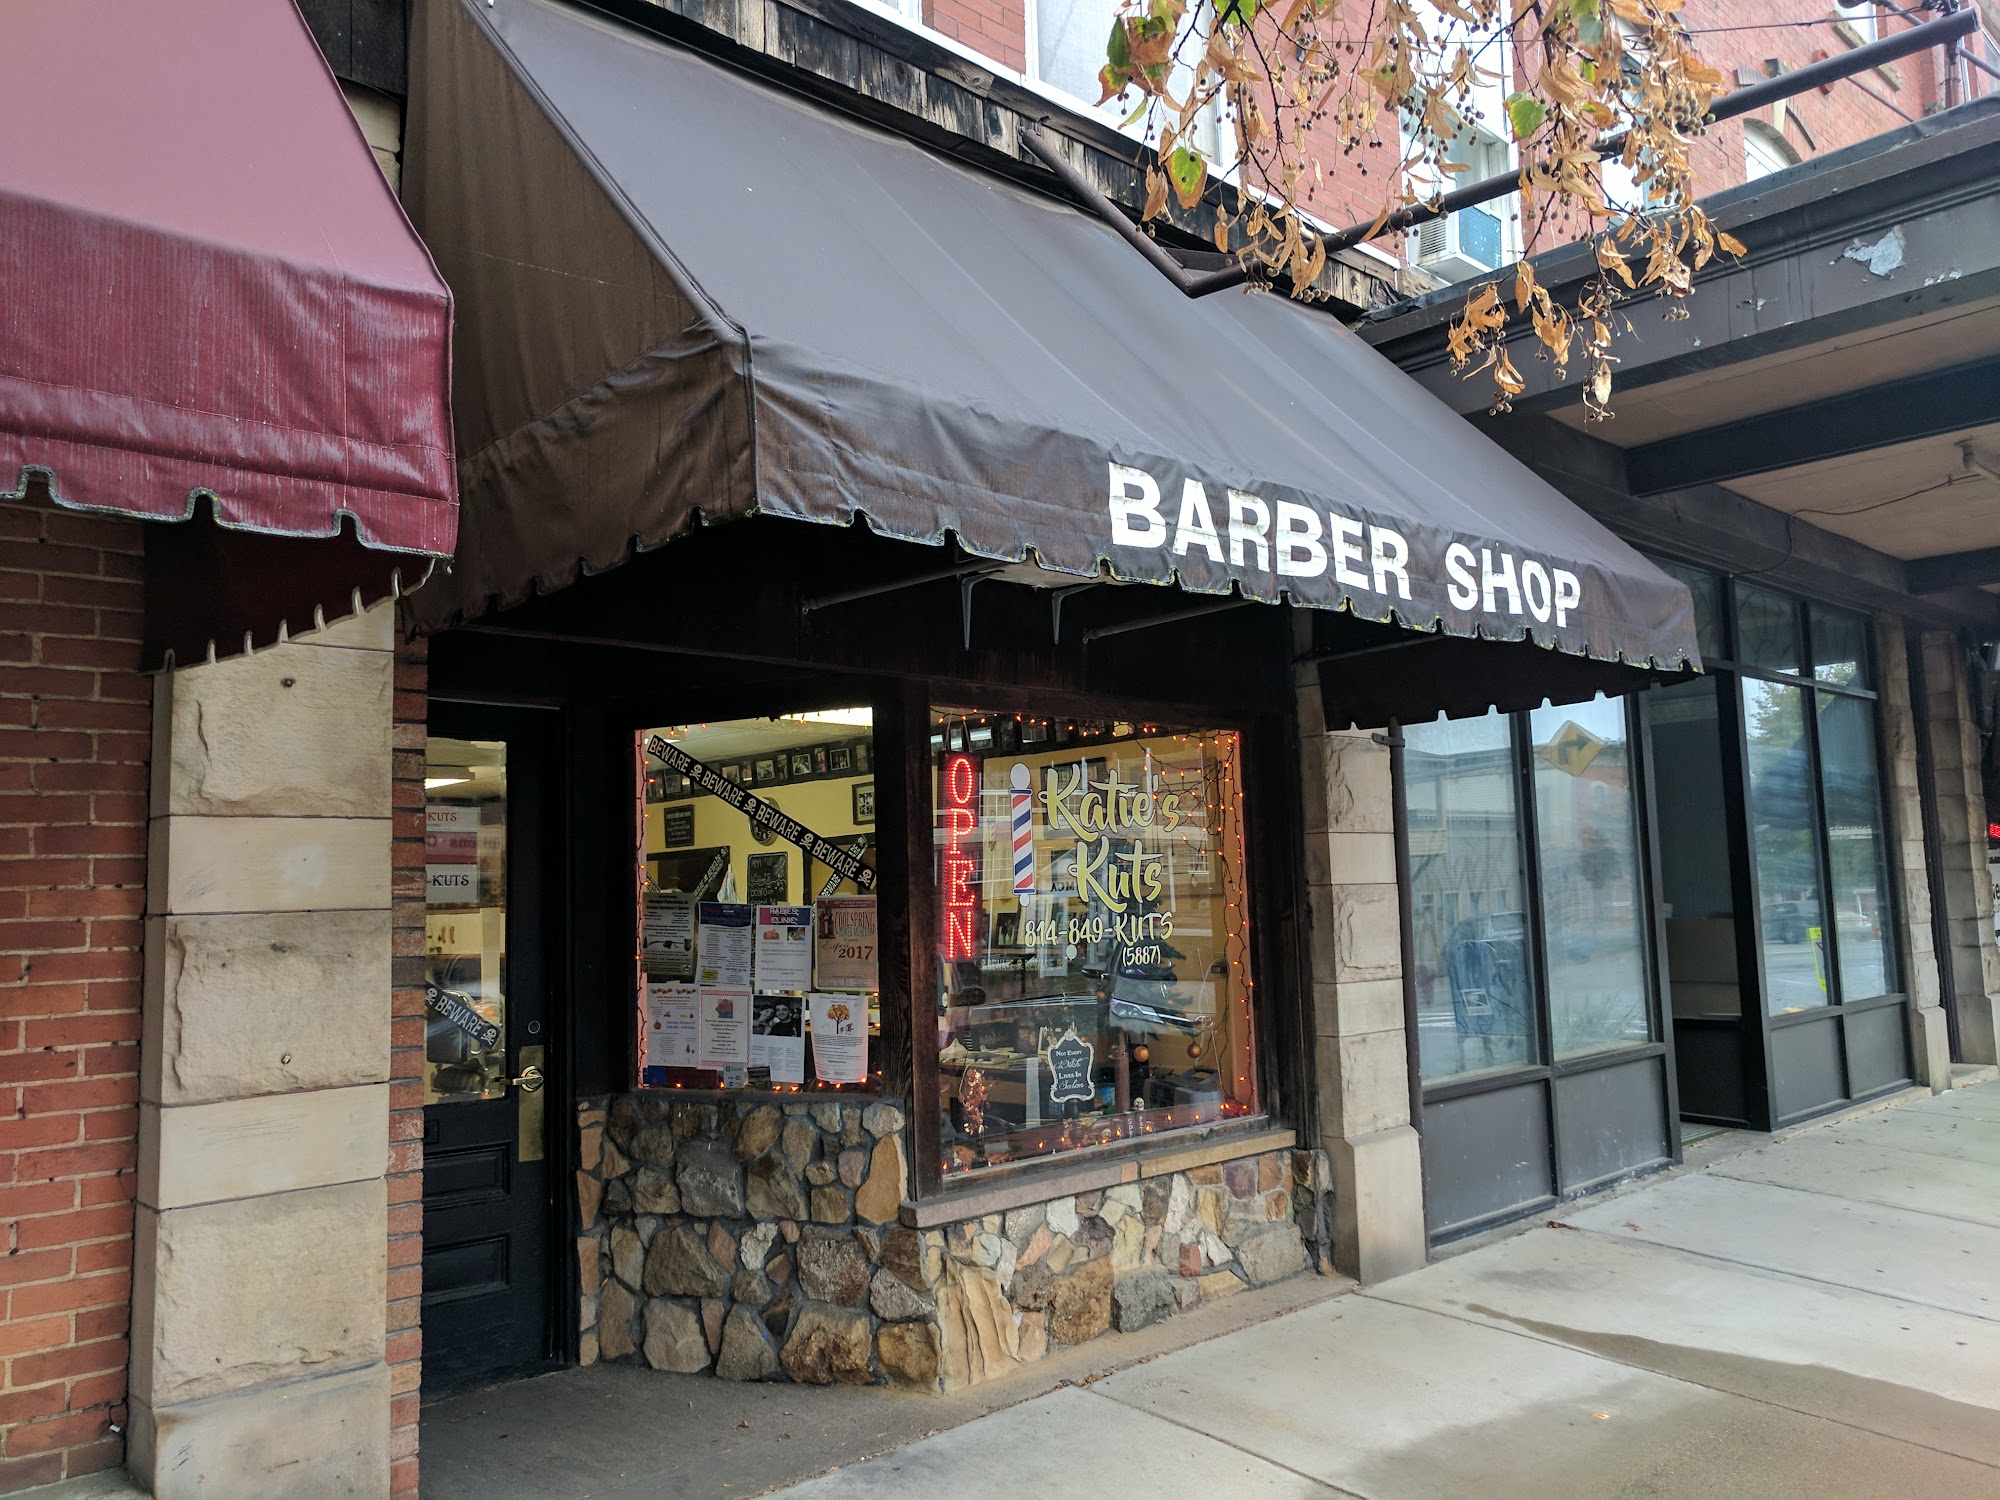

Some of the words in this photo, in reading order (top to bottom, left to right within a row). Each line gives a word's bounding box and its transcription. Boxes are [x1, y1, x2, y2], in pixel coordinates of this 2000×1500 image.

[1108, 461, 1412, 602] BARBER
[1445, 541, 1581, 628] SHOP
[649, 738, 691, 772] BEWARE
[701, 770, 745, 806] BEWARE
[756, 805, 801, 841] BEWARE
[812, 839, 860, 878] BEWARE
[1038, 763, 1180, 842] Katie's
[948, 757, 975, 959] OPEN
[1068, 835, 1164, 913] Kuts
[838, 946, 874, 960] 2017
[1024, 911, 1175, 948] 814-849-KUTS
[1122, 945, 1162, 967] (5887)
[434, 995, 484, 1038] BEWARE
